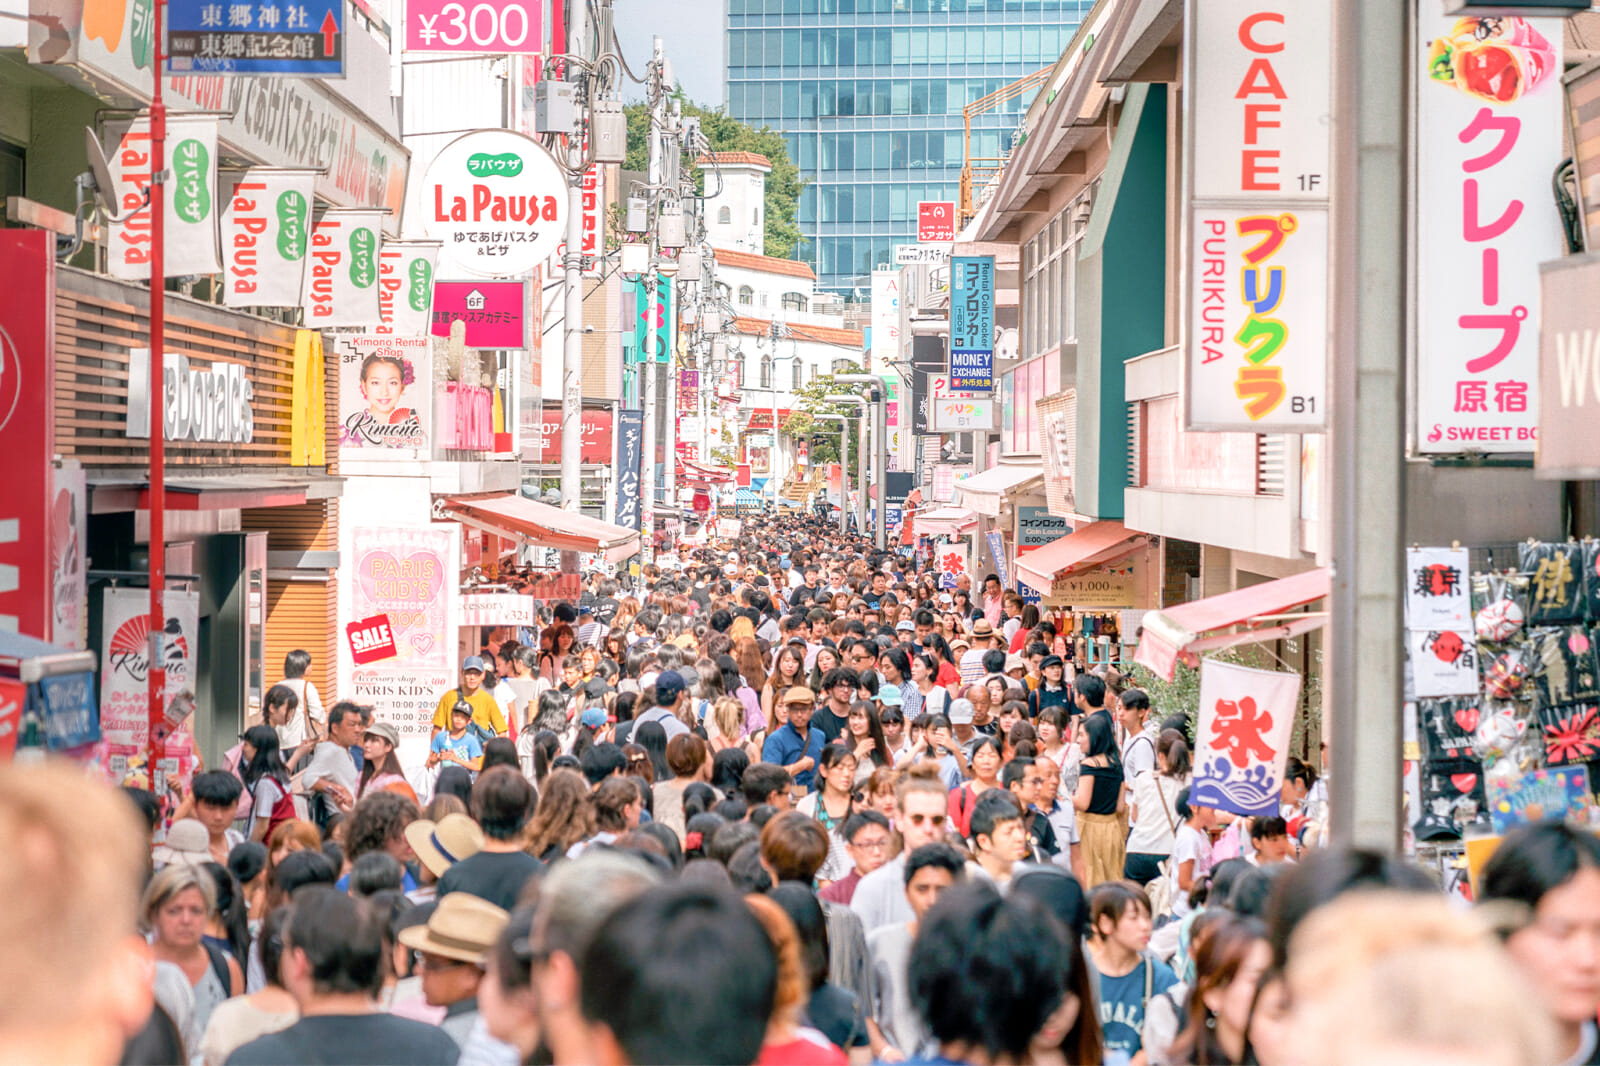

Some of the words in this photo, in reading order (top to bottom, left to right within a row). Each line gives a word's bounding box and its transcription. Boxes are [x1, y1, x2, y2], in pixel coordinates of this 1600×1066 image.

[201, 3, 308, 28] 東郷神社
[418, 3, 529, 46] ¥300
[200, 33, 315, 58] 東郷記念館
[1234, 12, 1288, 191] CAFE
[1297, 175, 1321, 191] 1F
[453, 231, 539, 243] ゆであげパスタ
[1457, 107, 1529, 374] クレープ
[477, 245, 509, 256] &ピザ
[981, 263, 990, 291] Rental
[1201, 220, 1226, 364] PURIKURA
[468, 297, 482, 307] 6F
[966, 263, 979, 347] コインロッカー
[981, 294, 990, 314] Coin
[1233, 212, 1298, 421] プリクラ
[981, 317, 990, 348] Locker
[353, 338, 392, 347] Kimono
[396, 338, 427, 347] Rental
[343, 355, 357, 363] 3F
[376, 347, 403, 358] Shop
[952, 354, 991, 366] MONEY
[952, 368, 991, 377] EXCHANGE
[1291, 396, 1316, 413] B1
[1453, 380, 1528, 413] 原宿
[345, 411, 423, 446] Kimono
[1447, 427, 1513, 440] SWEET
[383, 437, 423, 446] TOKYO
[1025, 527, 1042, 535] Coin
[1042, 527, 1066, 535] Locker
[371, 559, 435, 578] PARIS
[942, 552, 965, 575] 氷
[375, 581, 430, 600] KID'S
[1070, 581, 1110, 592] ¥1,000
[1413, 566, 1462, 598] 東京
[1022, 586, 1039, 598] EXC
[376, 610, 426, 628] 300
[350, 624, 391, 650] SALE
[110, 648, 186, 682] Kimno
[357, 674, 394, 684] Accessory
[397, 674, 417, 684] shop
[355, 685, 395, 696] PARIS
[398, 685, 434, 696] KID'S
[391, 713, 433, 721] 10:00-20:0
[1209, 696, 1278, 769] 氷
